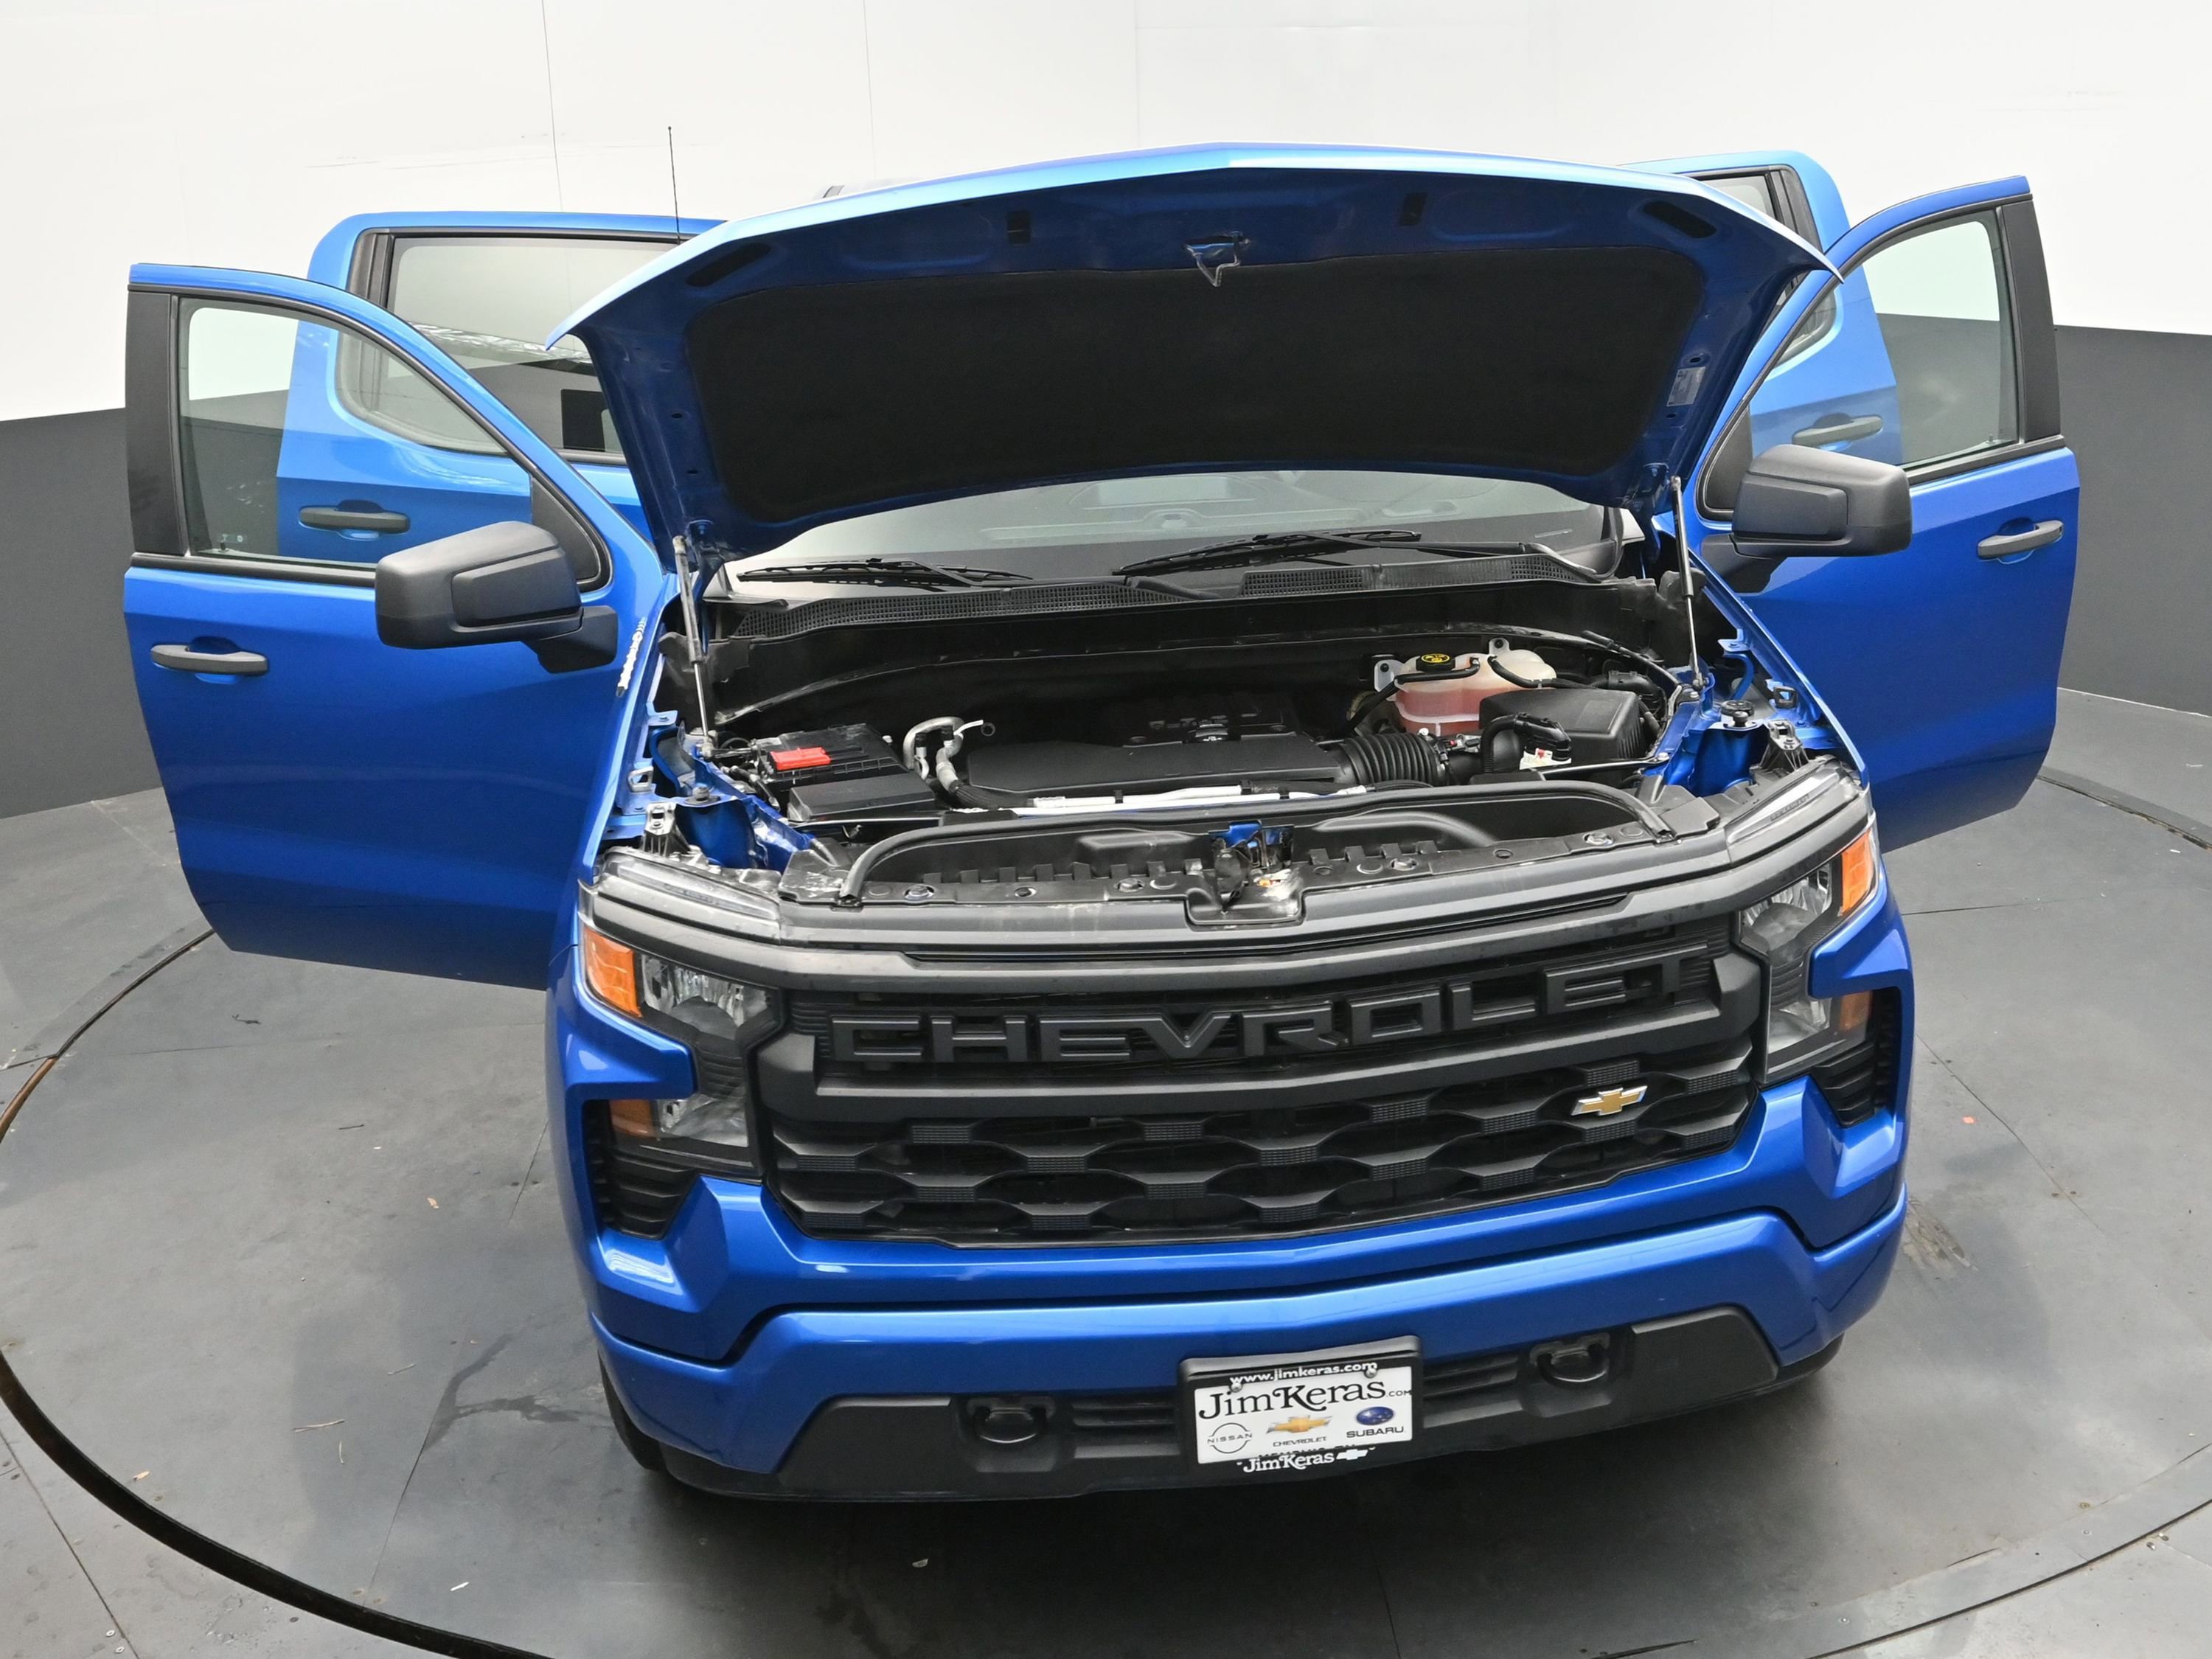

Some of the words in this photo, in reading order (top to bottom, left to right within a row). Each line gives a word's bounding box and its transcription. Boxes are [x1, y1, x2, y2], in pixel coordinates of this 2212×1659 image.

[830, 943, 1708, 1062] CHEVROLET
[1229, 1362, 1377, 1384] www.jimkeras.com
[1346, 1426, 1404, 1438] SUBARU
[1207, 1433, 1253, 1444] NISSAN
[1273, 1436, 1326, 1447] CHEVROLET
